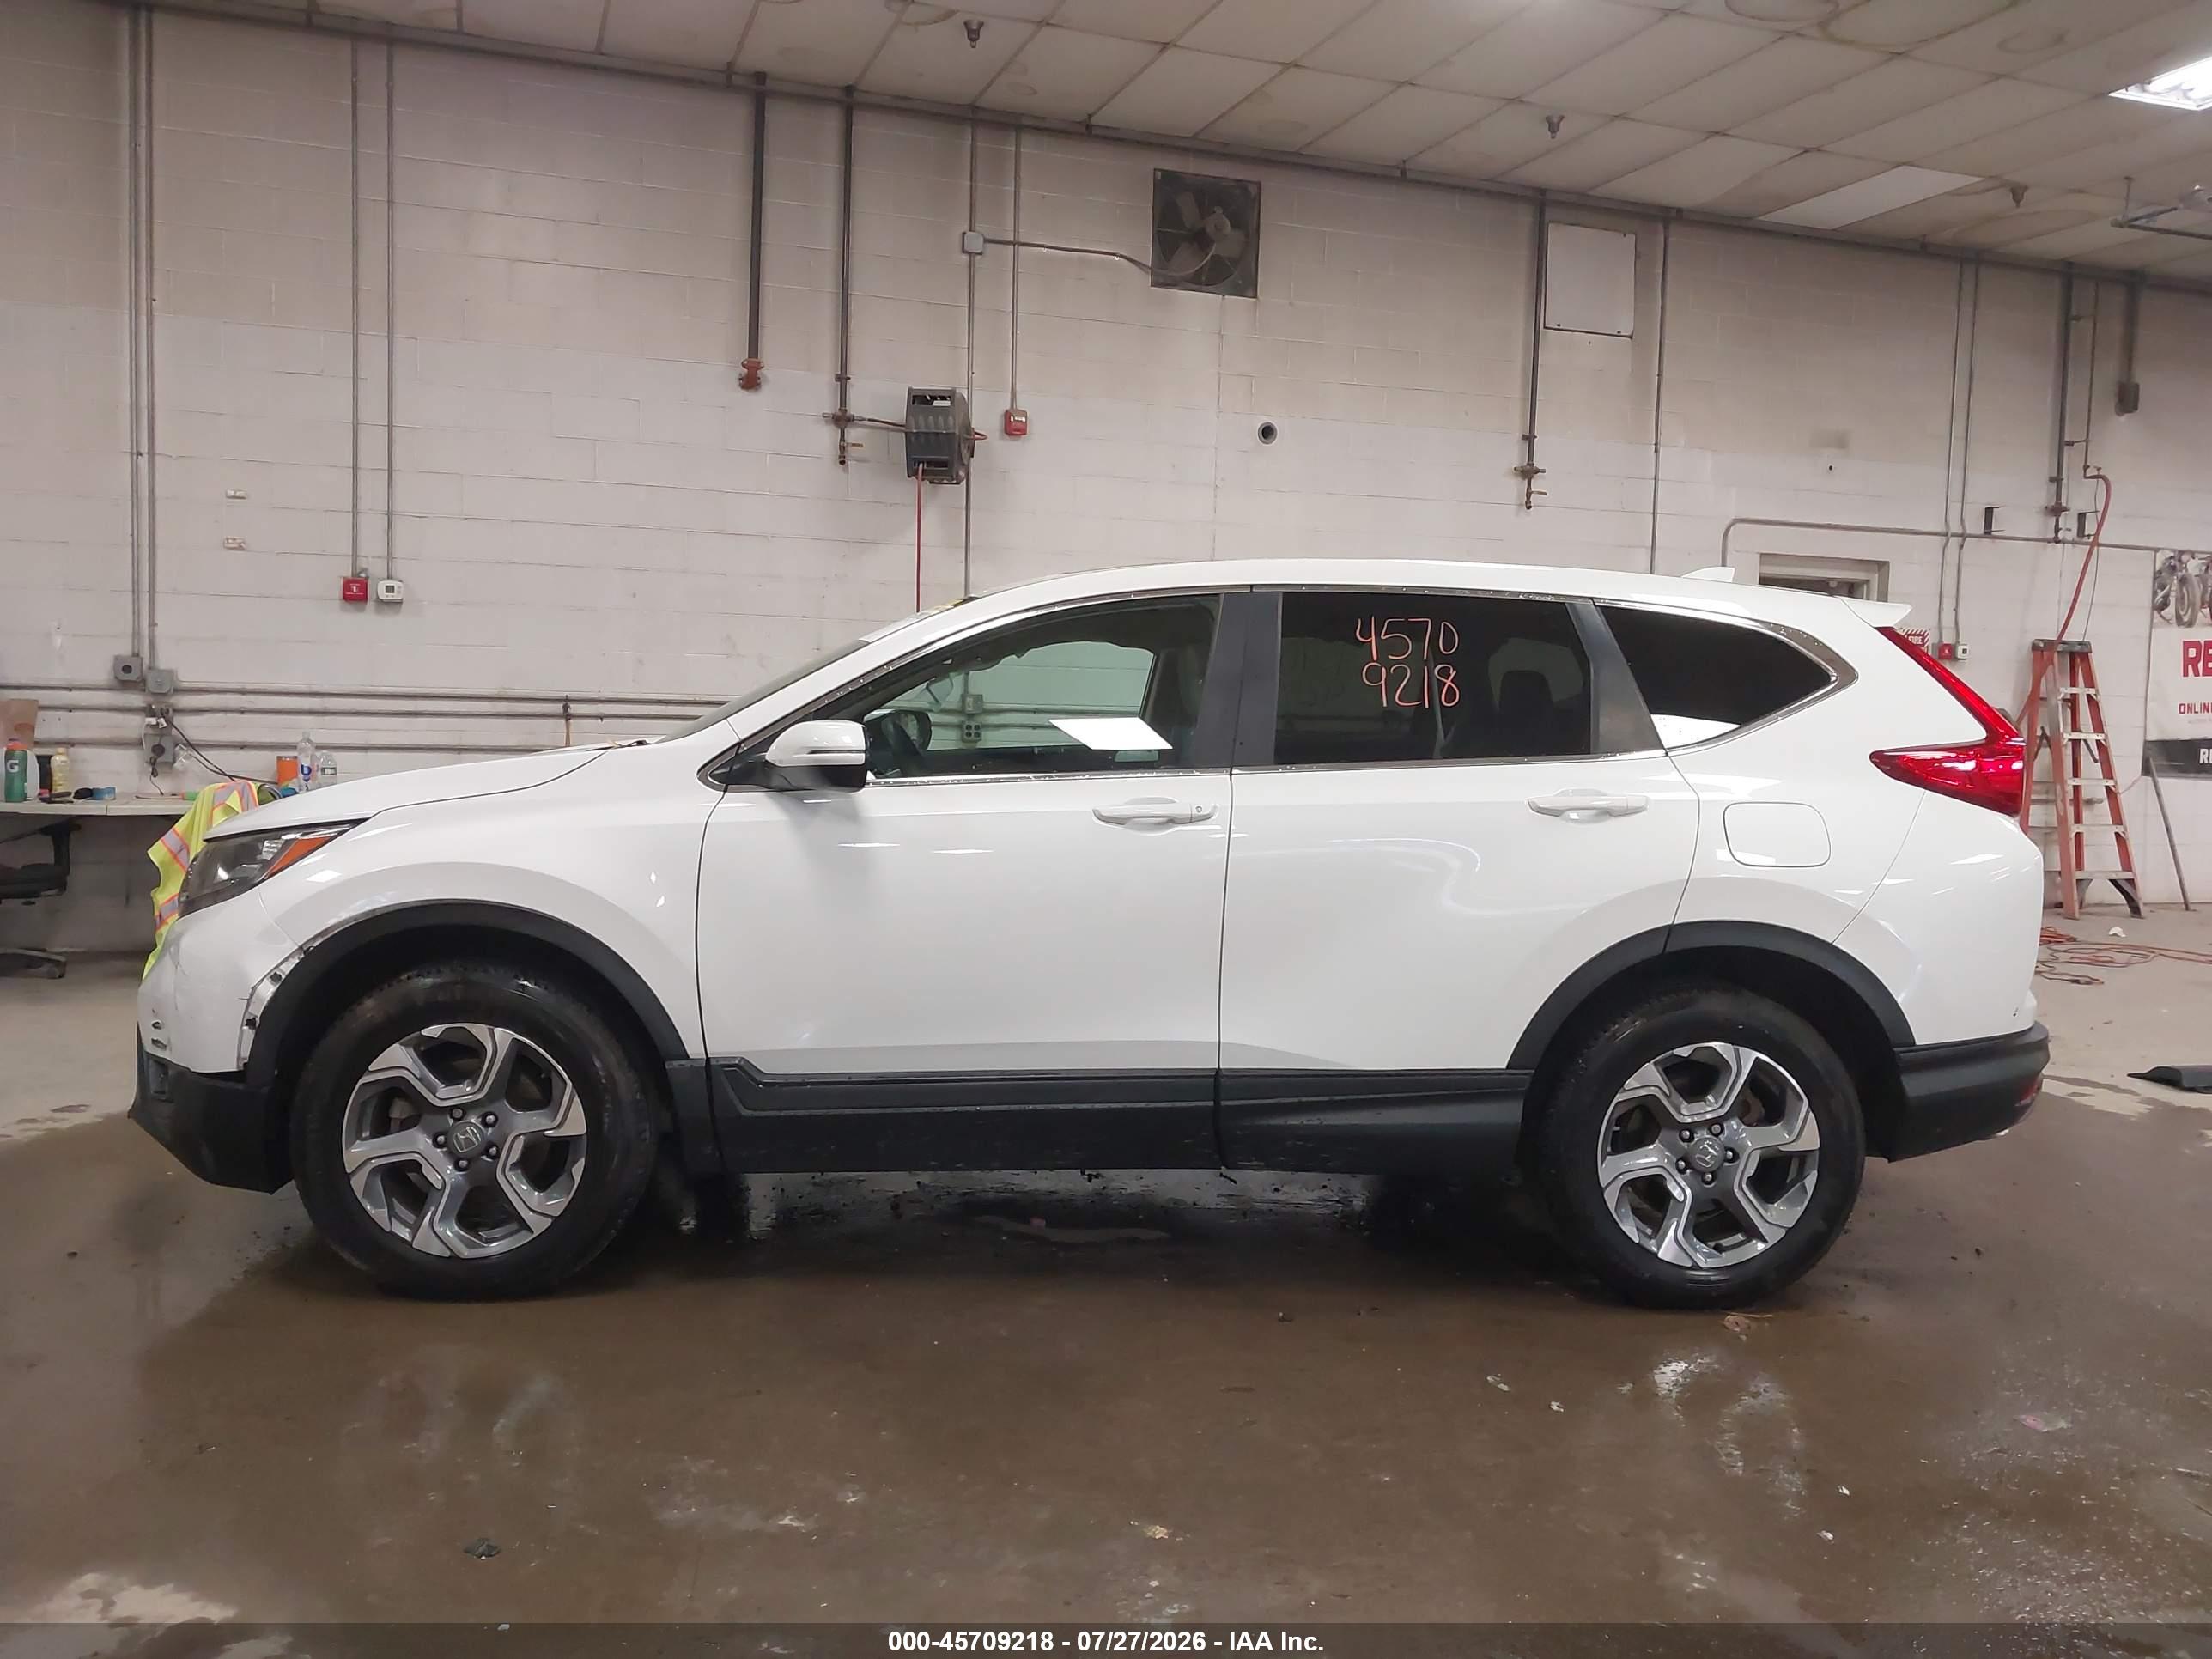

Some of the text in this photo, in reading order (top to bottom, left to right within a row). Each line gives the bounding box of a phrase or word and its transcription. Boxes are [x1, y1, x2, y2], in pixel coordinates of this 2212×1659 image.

[1356, 617, 1459, 660] 4570
[1362, 662, 1460, 708] 9218
[2179, 702, 2212, 714] ONLIN
